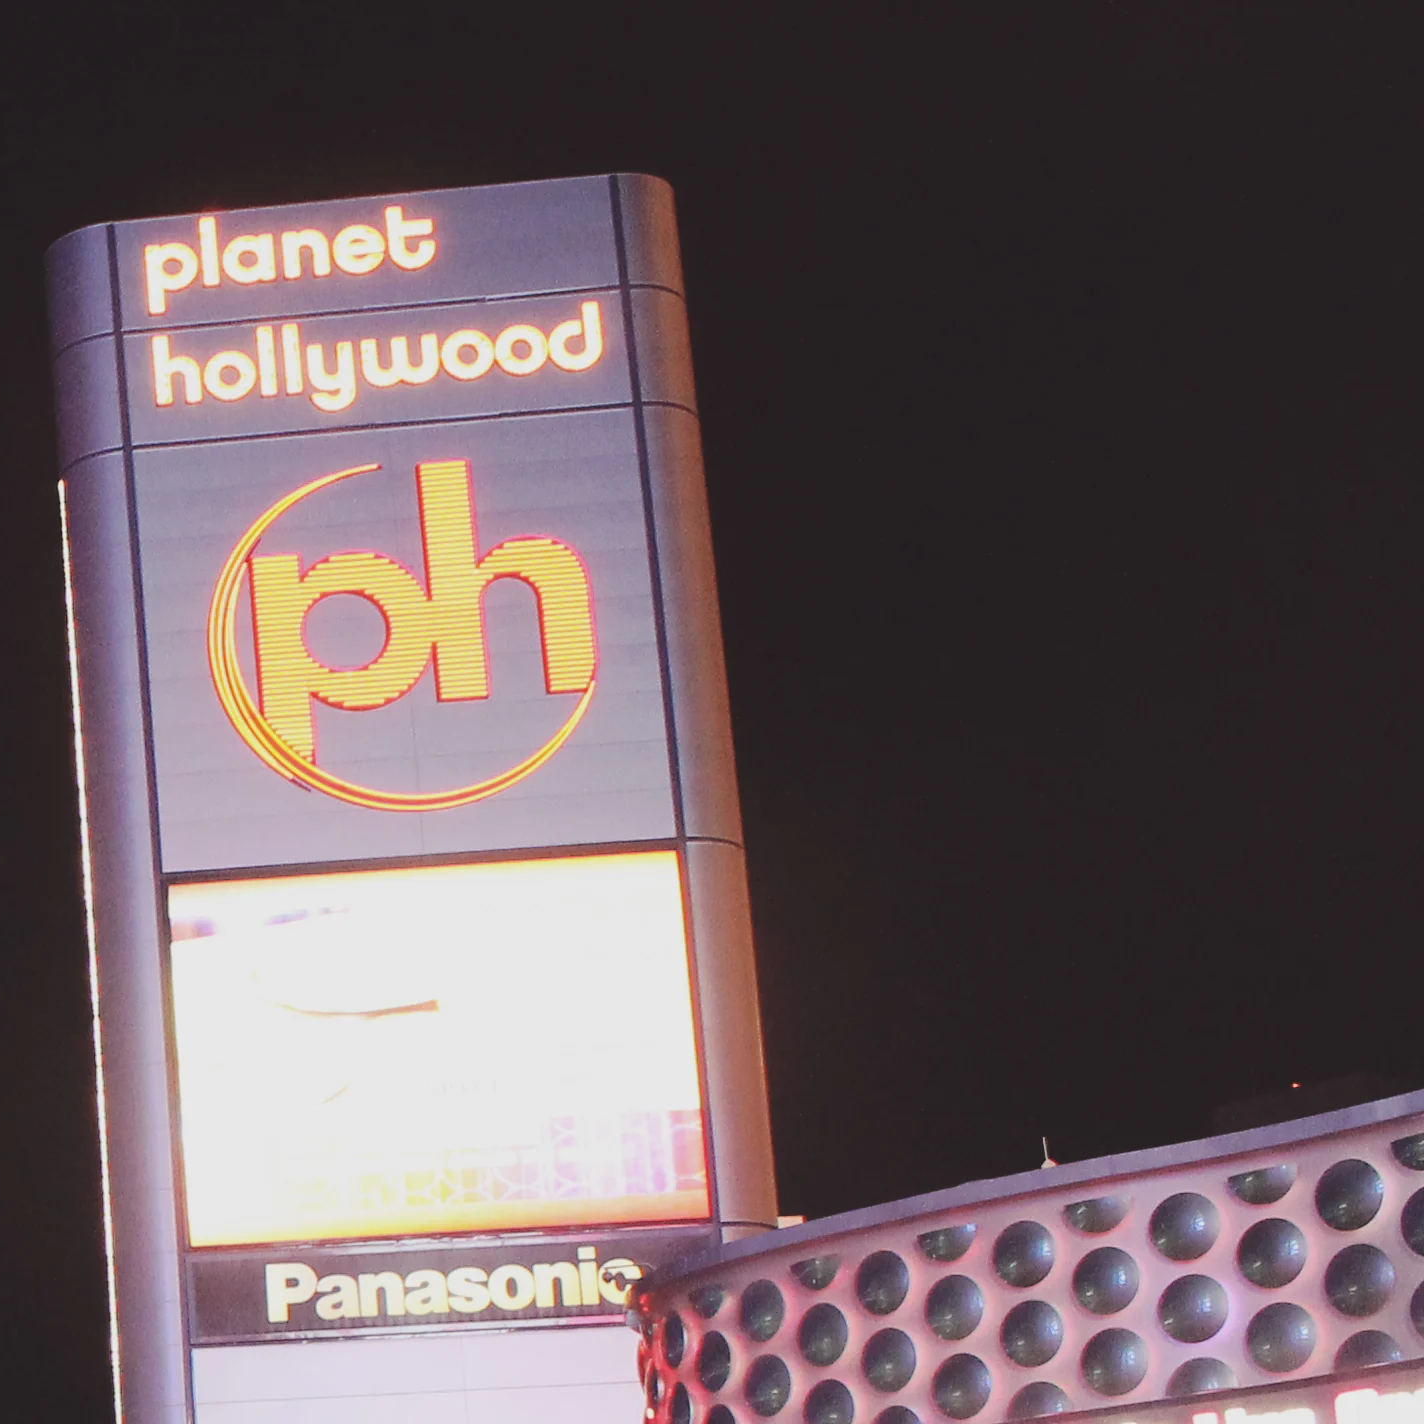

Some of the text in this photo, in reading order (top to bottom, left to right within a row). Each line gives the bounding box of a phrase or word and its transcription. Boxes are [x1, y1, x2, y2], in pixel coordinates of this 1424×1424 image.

[144, 205, 436, 314] planet
[151, 300, 604, 413] hollywood
[264, 1246, 644, 1324] Panasonic
